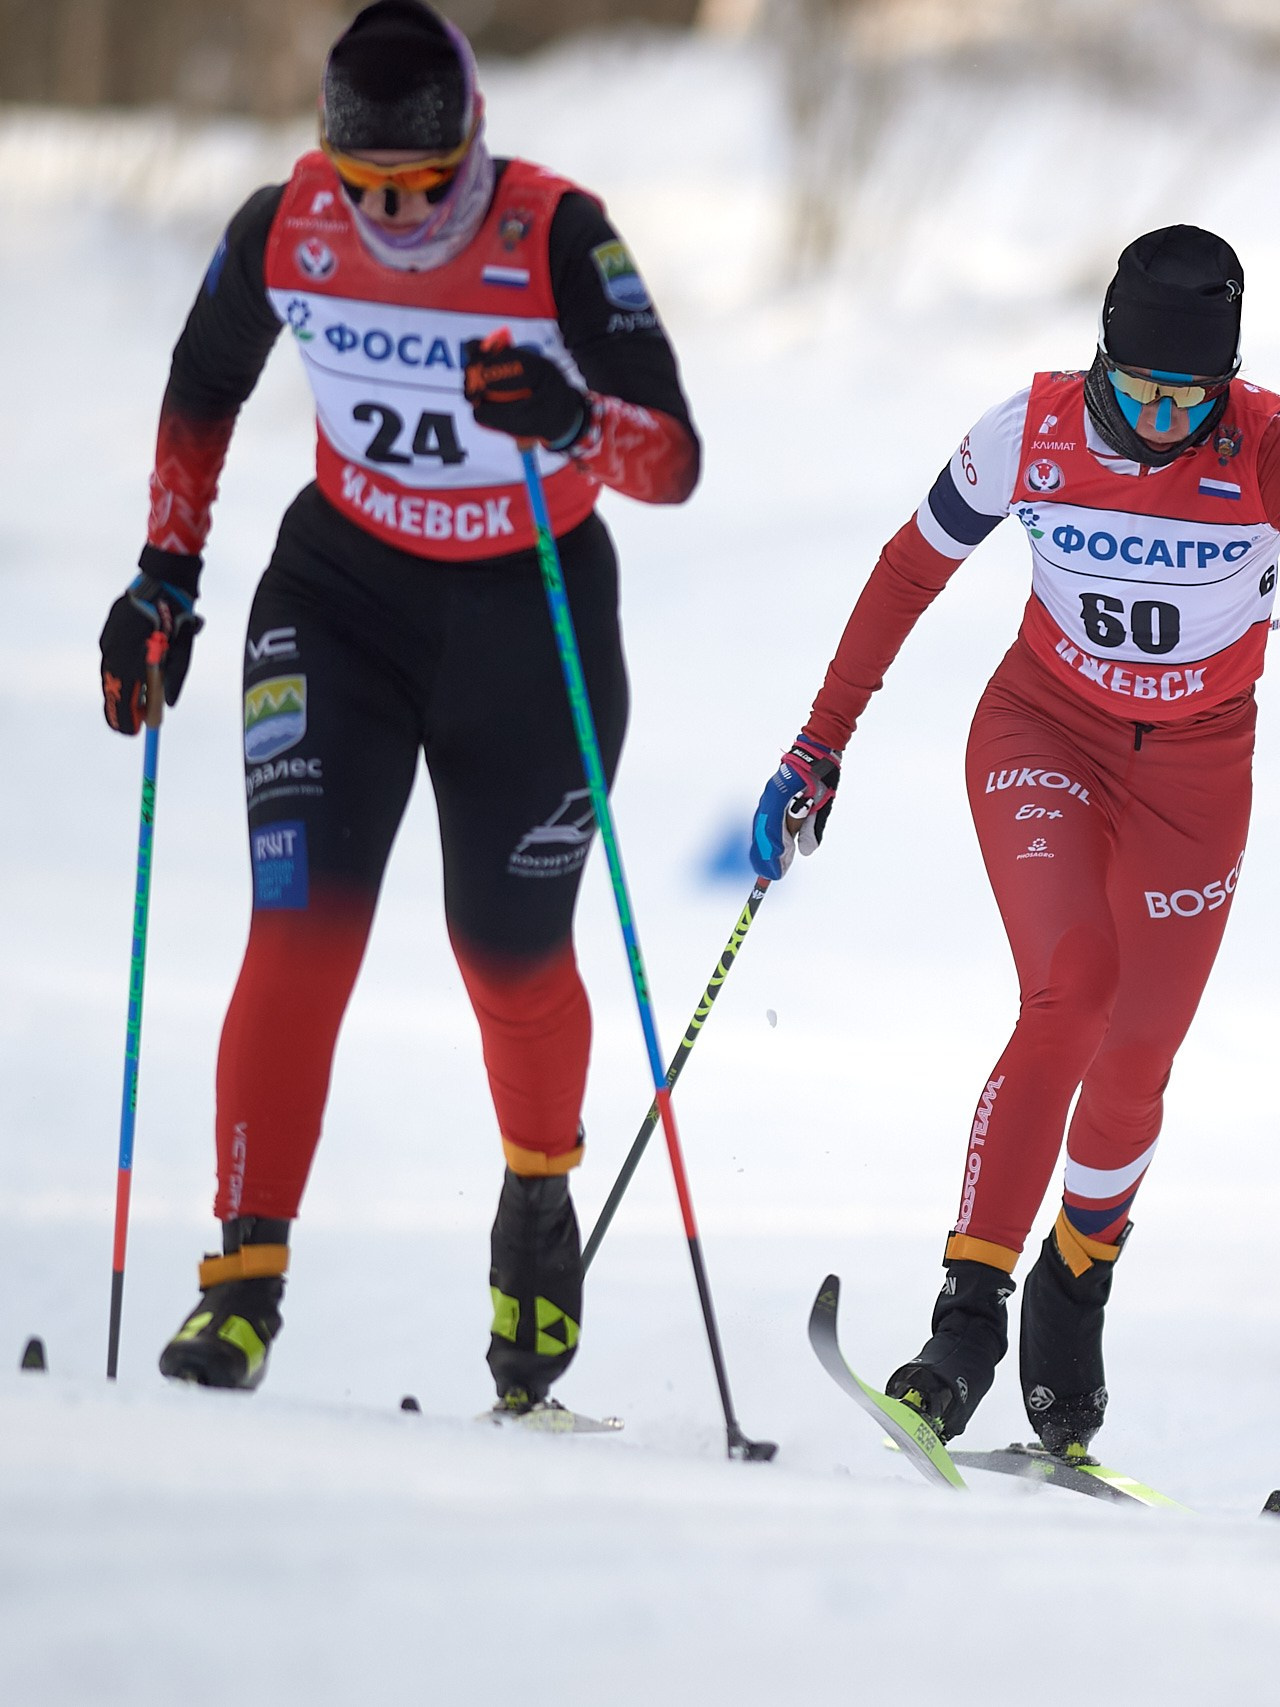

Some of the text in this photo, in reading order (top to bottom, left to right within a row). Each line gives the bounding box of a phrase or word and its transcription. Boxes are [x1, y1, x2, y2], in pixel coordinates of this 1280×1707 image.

[325, 323, 543, 370] ФОСА
[352, 399, 468, 465] 24
[1031, 440, 1077, 451] КЛИМАТ
[341, 465, 514, 541] ИЖЕВСК
[1052, 524, 1252, 569] ФОСАГРО
[1259, 562, 1278, 598] 6
[1079, 592, 1180, 655] 60
[1055, 638, 1207, 701] ИЖЕВСК
[985, 767, 1091, 806] LUKOIL
[1015, 803, 1063, 821] En+
[970, 1075, 1005, 1149] TEAM
